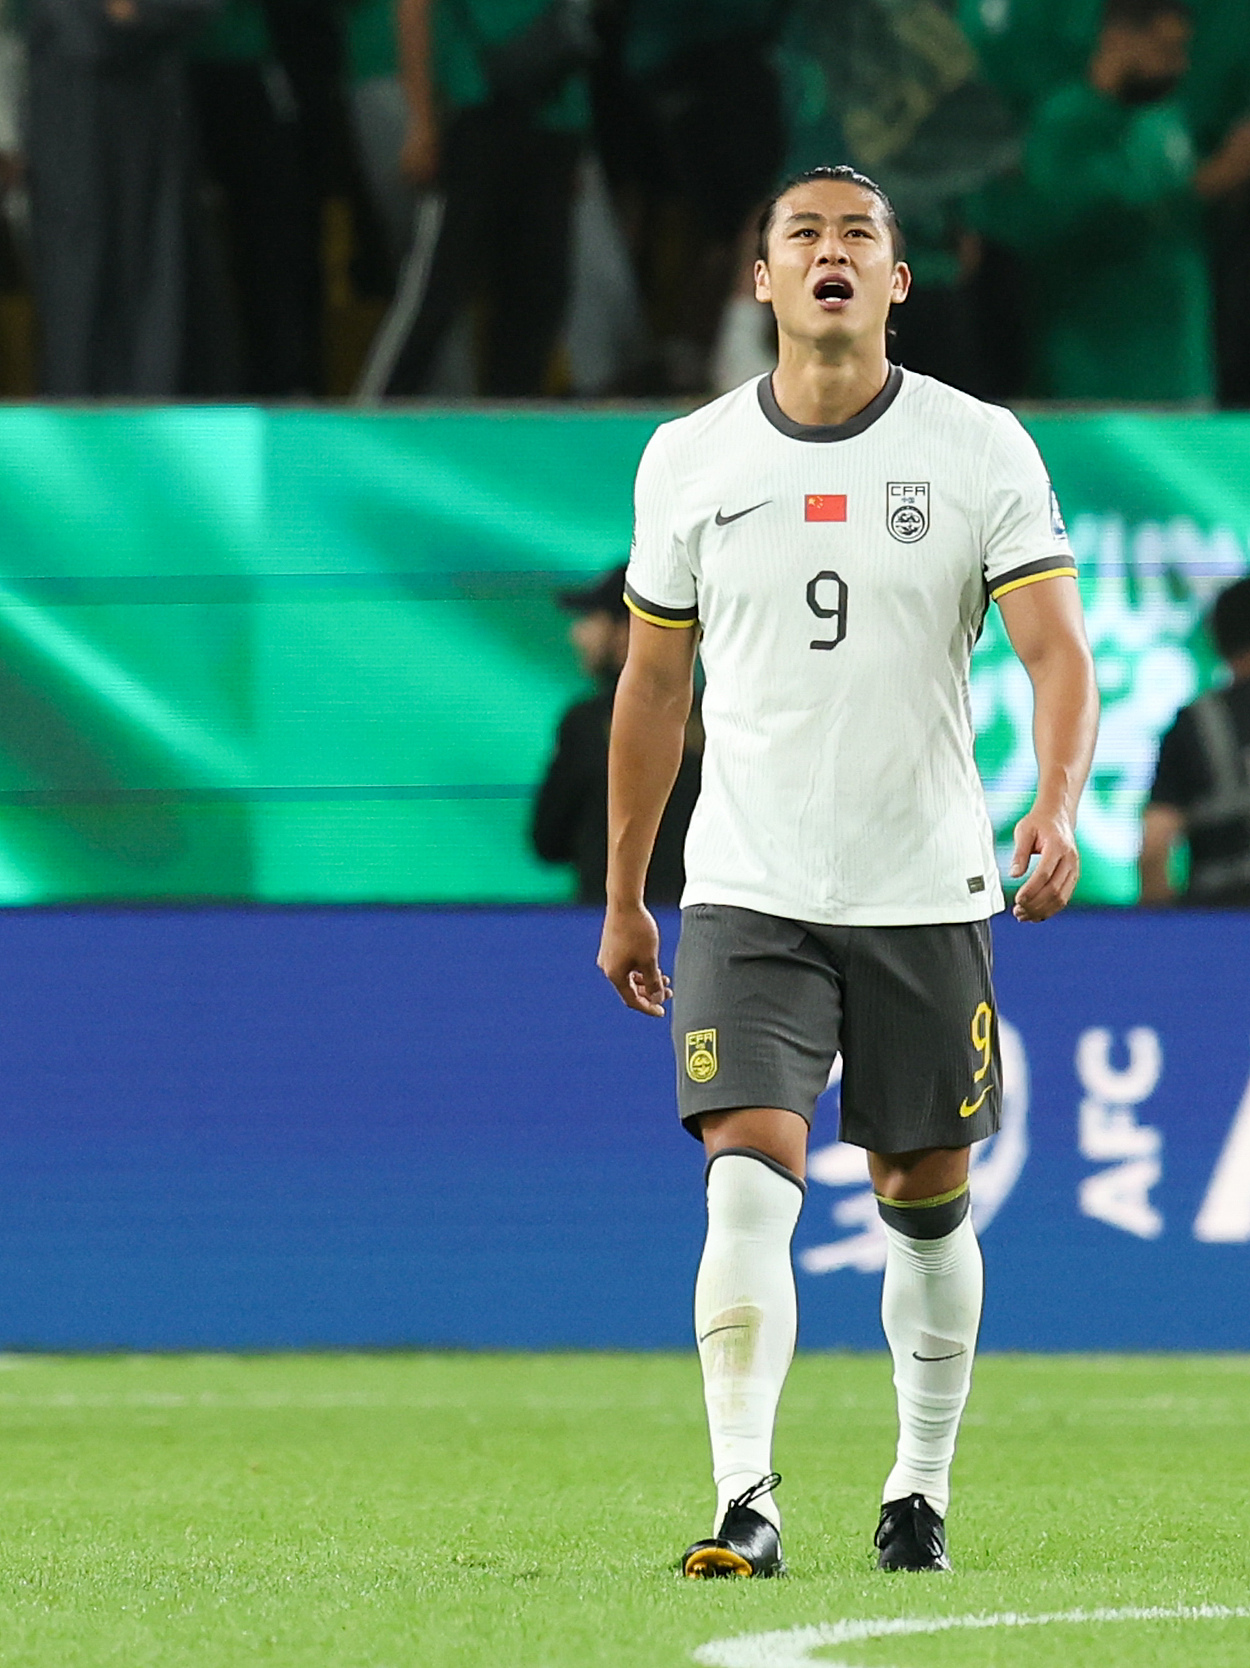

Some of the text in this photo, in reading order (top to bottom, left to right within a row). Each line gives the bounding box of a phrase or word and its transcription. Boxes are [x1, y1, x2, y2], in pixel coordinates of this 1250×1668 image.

[891, 485, 926, 496] CFA
[806, 570, 848, 651] 9
[971, 1001, 992, 1084] 9
[1076, 1025, 1164, 1241] AFC
